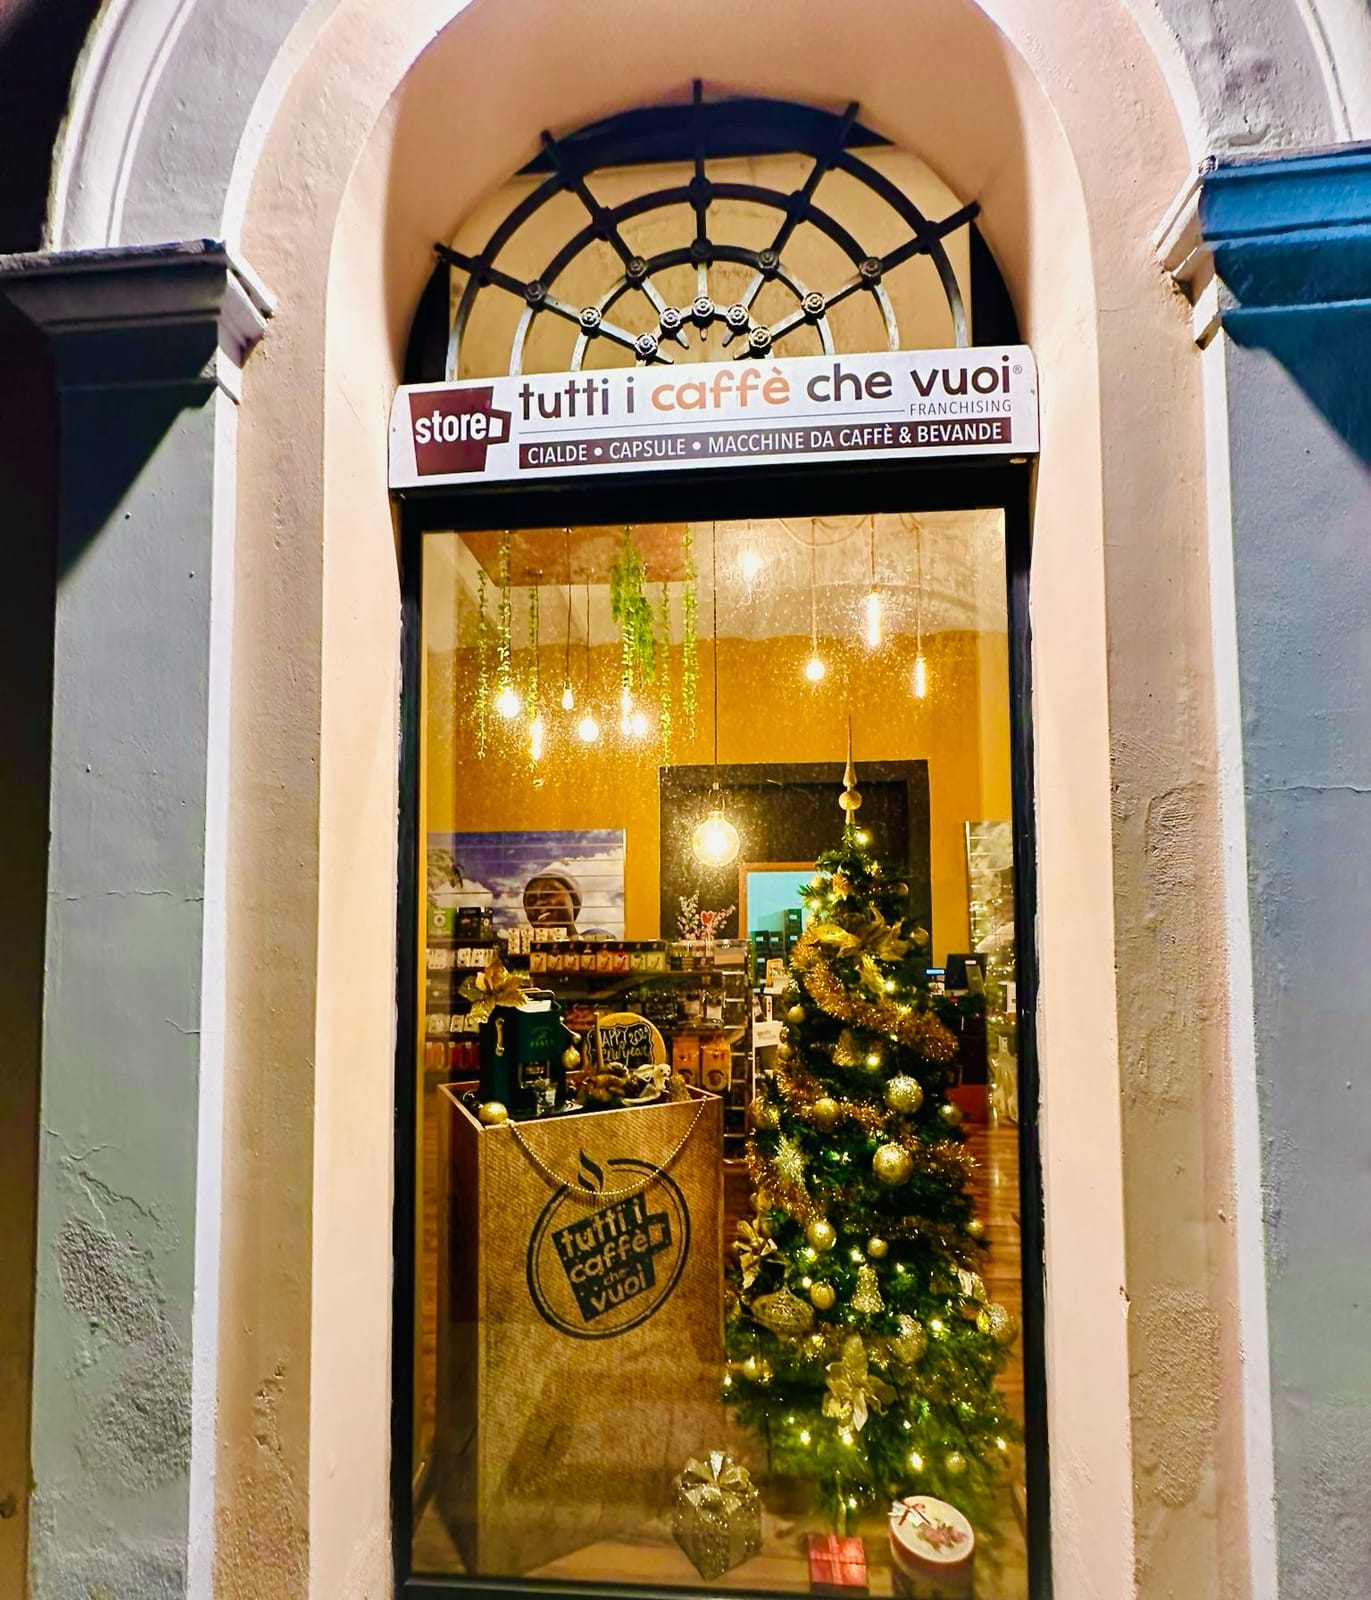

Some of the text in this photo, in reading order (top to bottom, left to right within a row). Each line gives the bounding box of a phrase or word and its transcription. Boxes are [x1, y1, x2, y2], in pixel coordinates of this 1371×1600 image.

[518, 377, 609, 421] tutti
[626, 375, 635, 414] i
[651, 366, 790, 412] caffè
[806, 363, 893, 403] che
[909, 399, 1012, 417] FRANCHISING
[415, 410, 487, 444] store
[527, 422, 1003, 465] CIALDE CAPSULE MACCHINE DA CAFFÈ & BEVANDE
[601, 1027, 628, 1047] APPY
[561, 1198, 643, 1258] tutti i
[569, 1229, 649, 1284] caffè
[590, 1263, 647, 1312] vuoi
